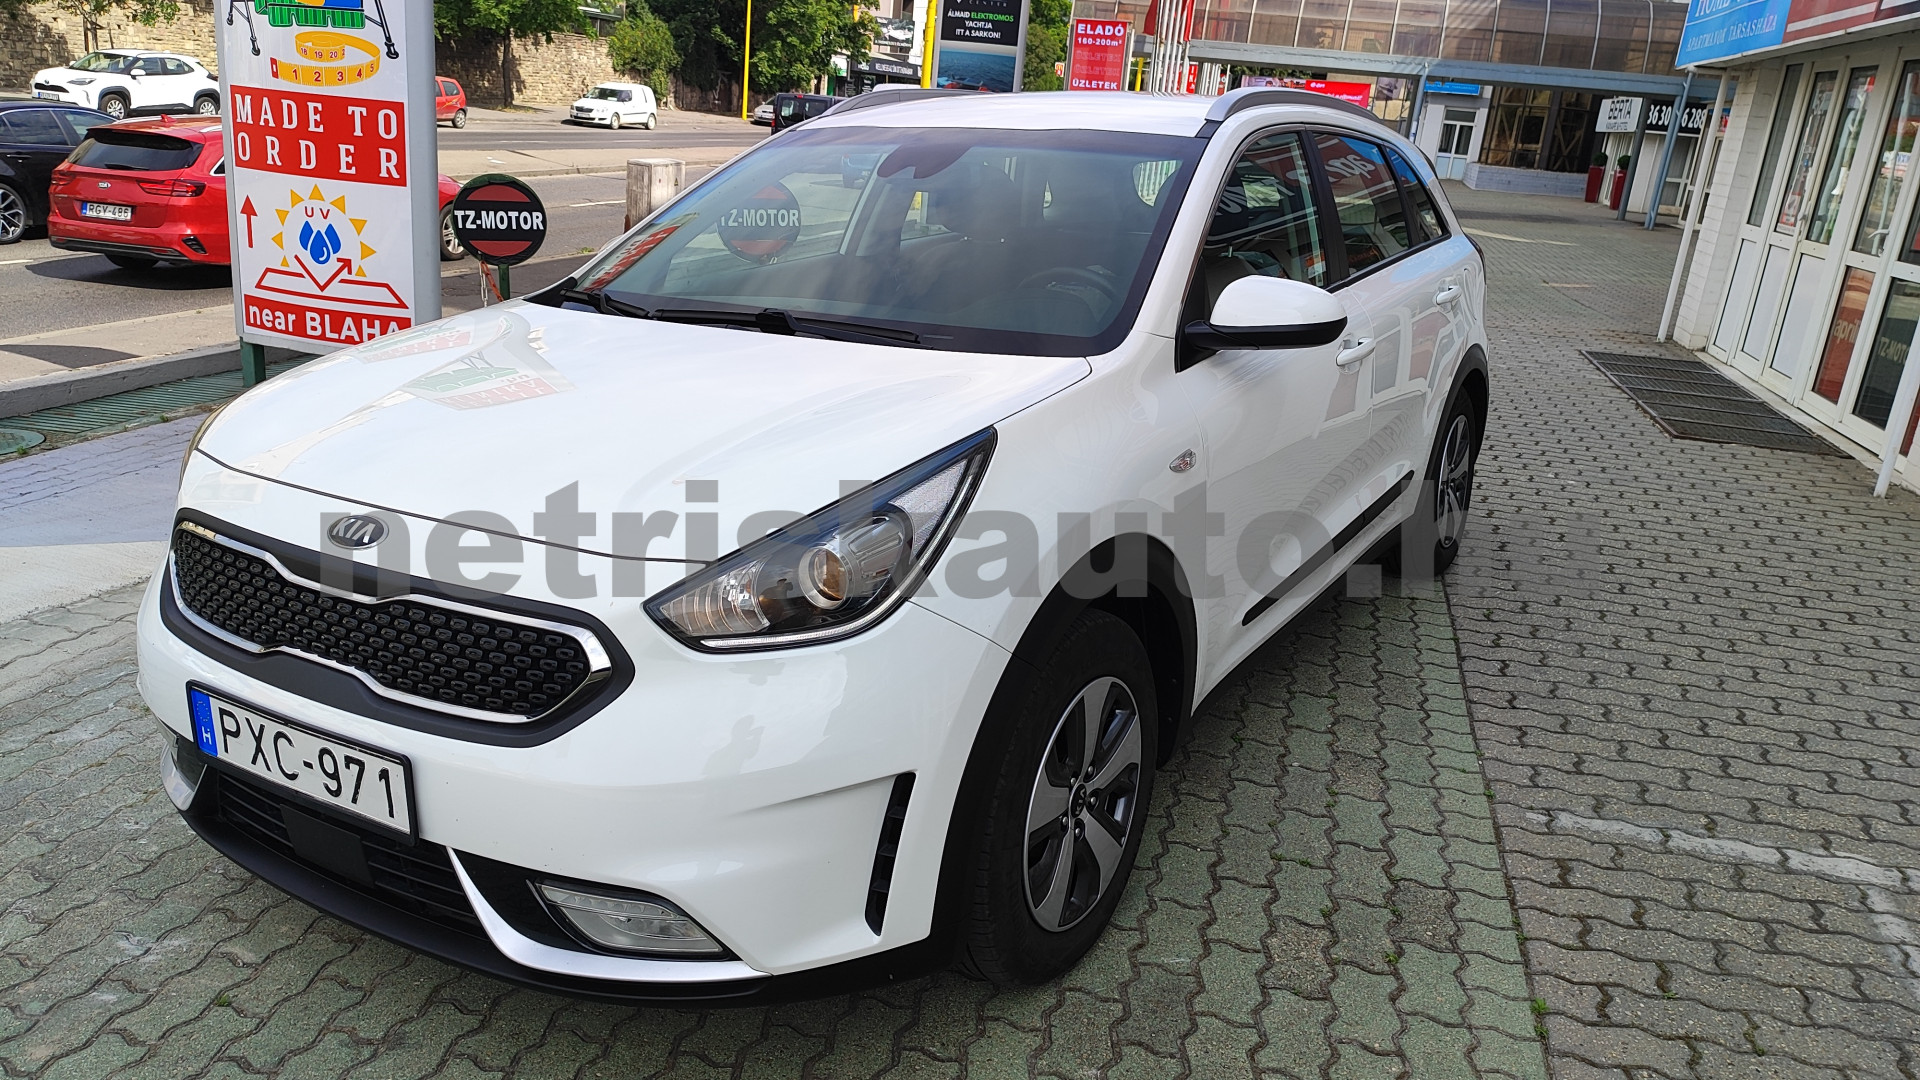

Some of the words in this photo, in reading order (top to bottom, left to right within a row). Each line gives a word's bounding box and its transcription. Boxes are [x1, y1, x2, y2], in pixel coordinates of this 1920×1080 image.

[965, 20, 993, 29] YACHTJA
[971, 12, 1014, 22] ELEKTROMOS
[971, 30, 1001, 39] SARKON!
[1077, 23, 1124, 37] ELADÓ
[301, 48, 308, 56] 18
[314, 51, 323, 59] 19
[292, 69, 298, 80] 1
[313, 71, 321, 82] 2
[337, 71, 344, 82] 3
[356, 68, 362, 78] 4
[369, 64, 374, 72] 5
[1072, 78, 1118, 90] ÜZLETEK
[234, 93, 324, 133] MADE
[347, 106, 398, 140] TO
[1608, 98, 1632, 120] BERTA
[236, 131, 400, 179] ORDER
[304, 205, 331, 220] UV
[454, 209, 545, 230] TZ-MOTOR
[249, 305, 296, 332] near
[331, 517, 376, 544] KIA
[201, 725, 212, 746] H
[218, 706, 394, 818] PXC-971
